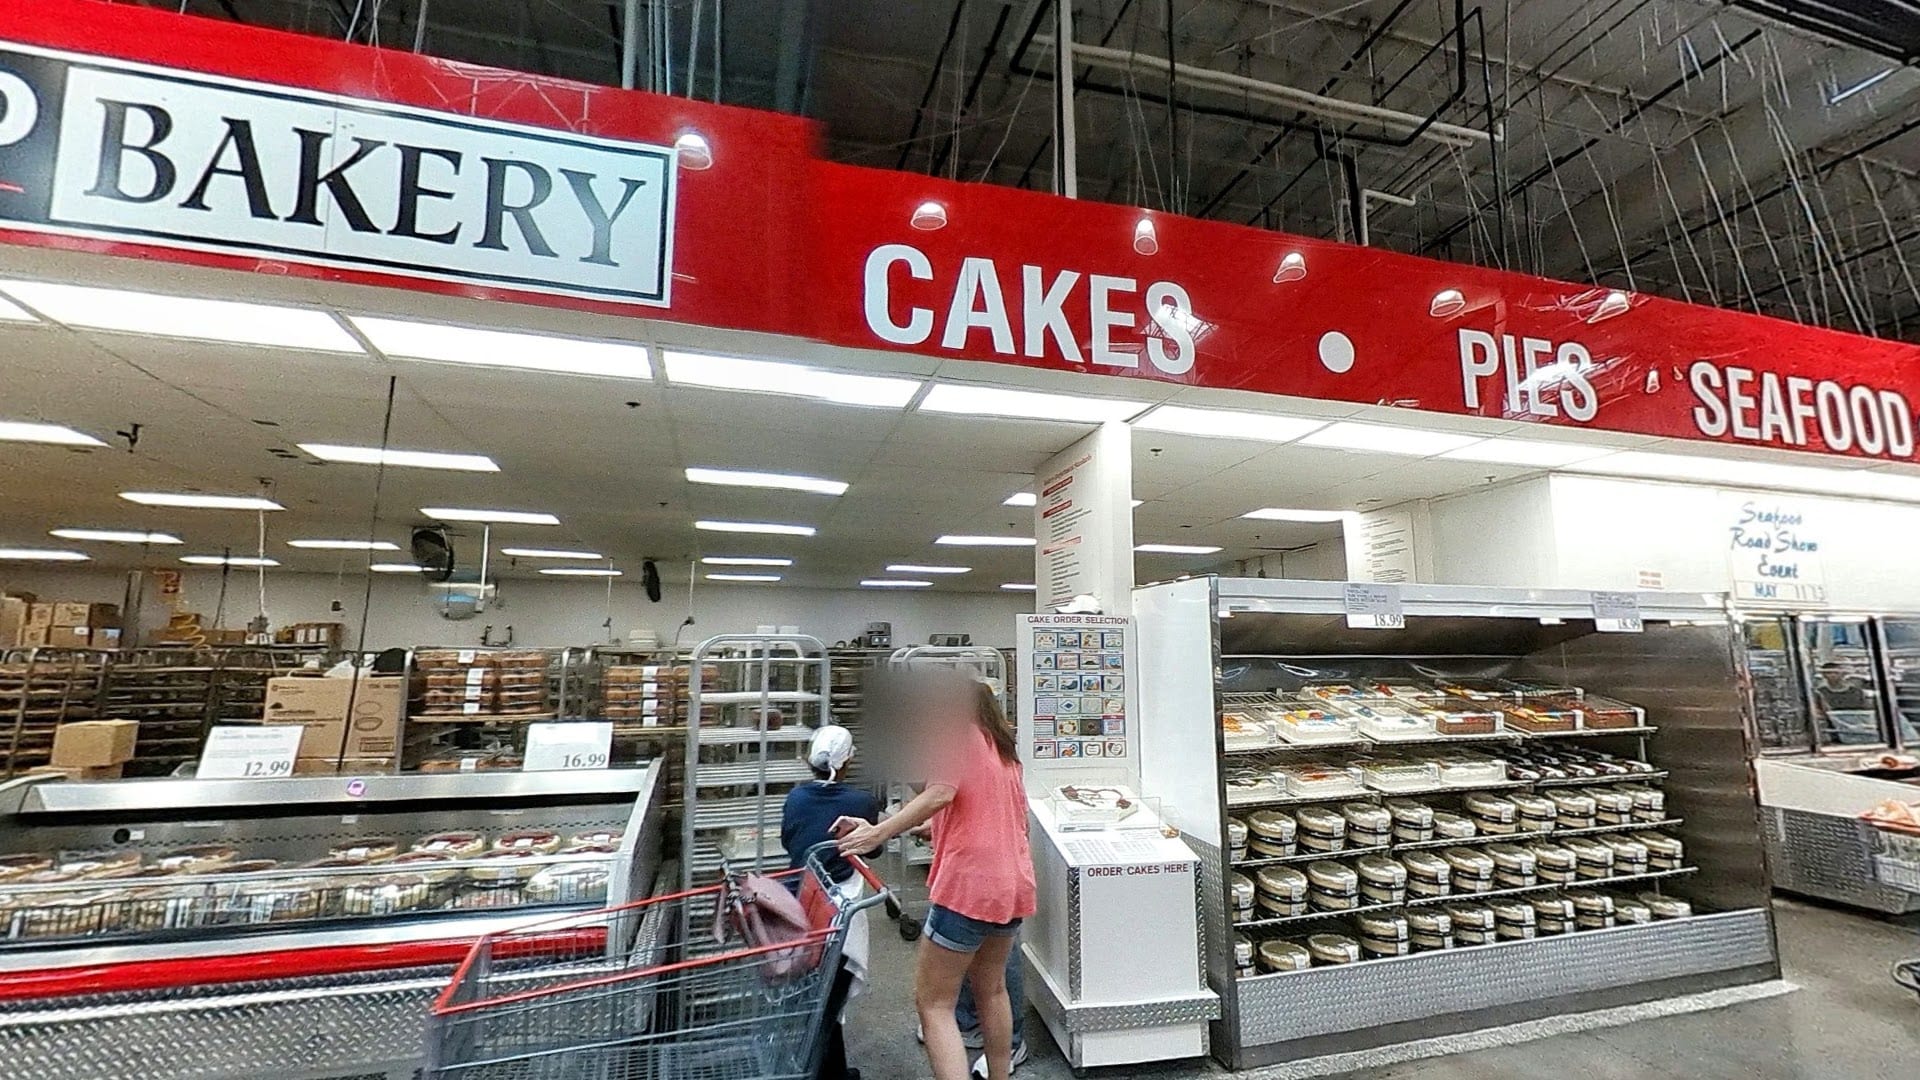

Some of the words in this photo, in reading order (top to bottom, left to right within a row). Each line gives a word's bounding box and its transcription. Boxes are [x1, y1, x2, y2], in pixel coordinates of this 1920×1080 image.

[83, 97, 646, 267] BAKERY
[864, 243, 1196, 375] CAKES
[1458, 328, 1597, 422] PIES
[1690, 361, 1913, 457] SEAFOOD
[1027, 615, 1051, 624] CAKE
[1053, 615, 1082, 625] ORDER
[1085, 616, 1129, 625] SELECTION
[1374, 614, 1402, 626] 18.99
[562, 753, 607, 768] 16.99
[243, 760, 291, 777] 12.99
[1087, 866, 1123, 877] ORDER
[1127, 865, 1160, 875] CAKES
[1163, 863, 1189, 873] HERE
